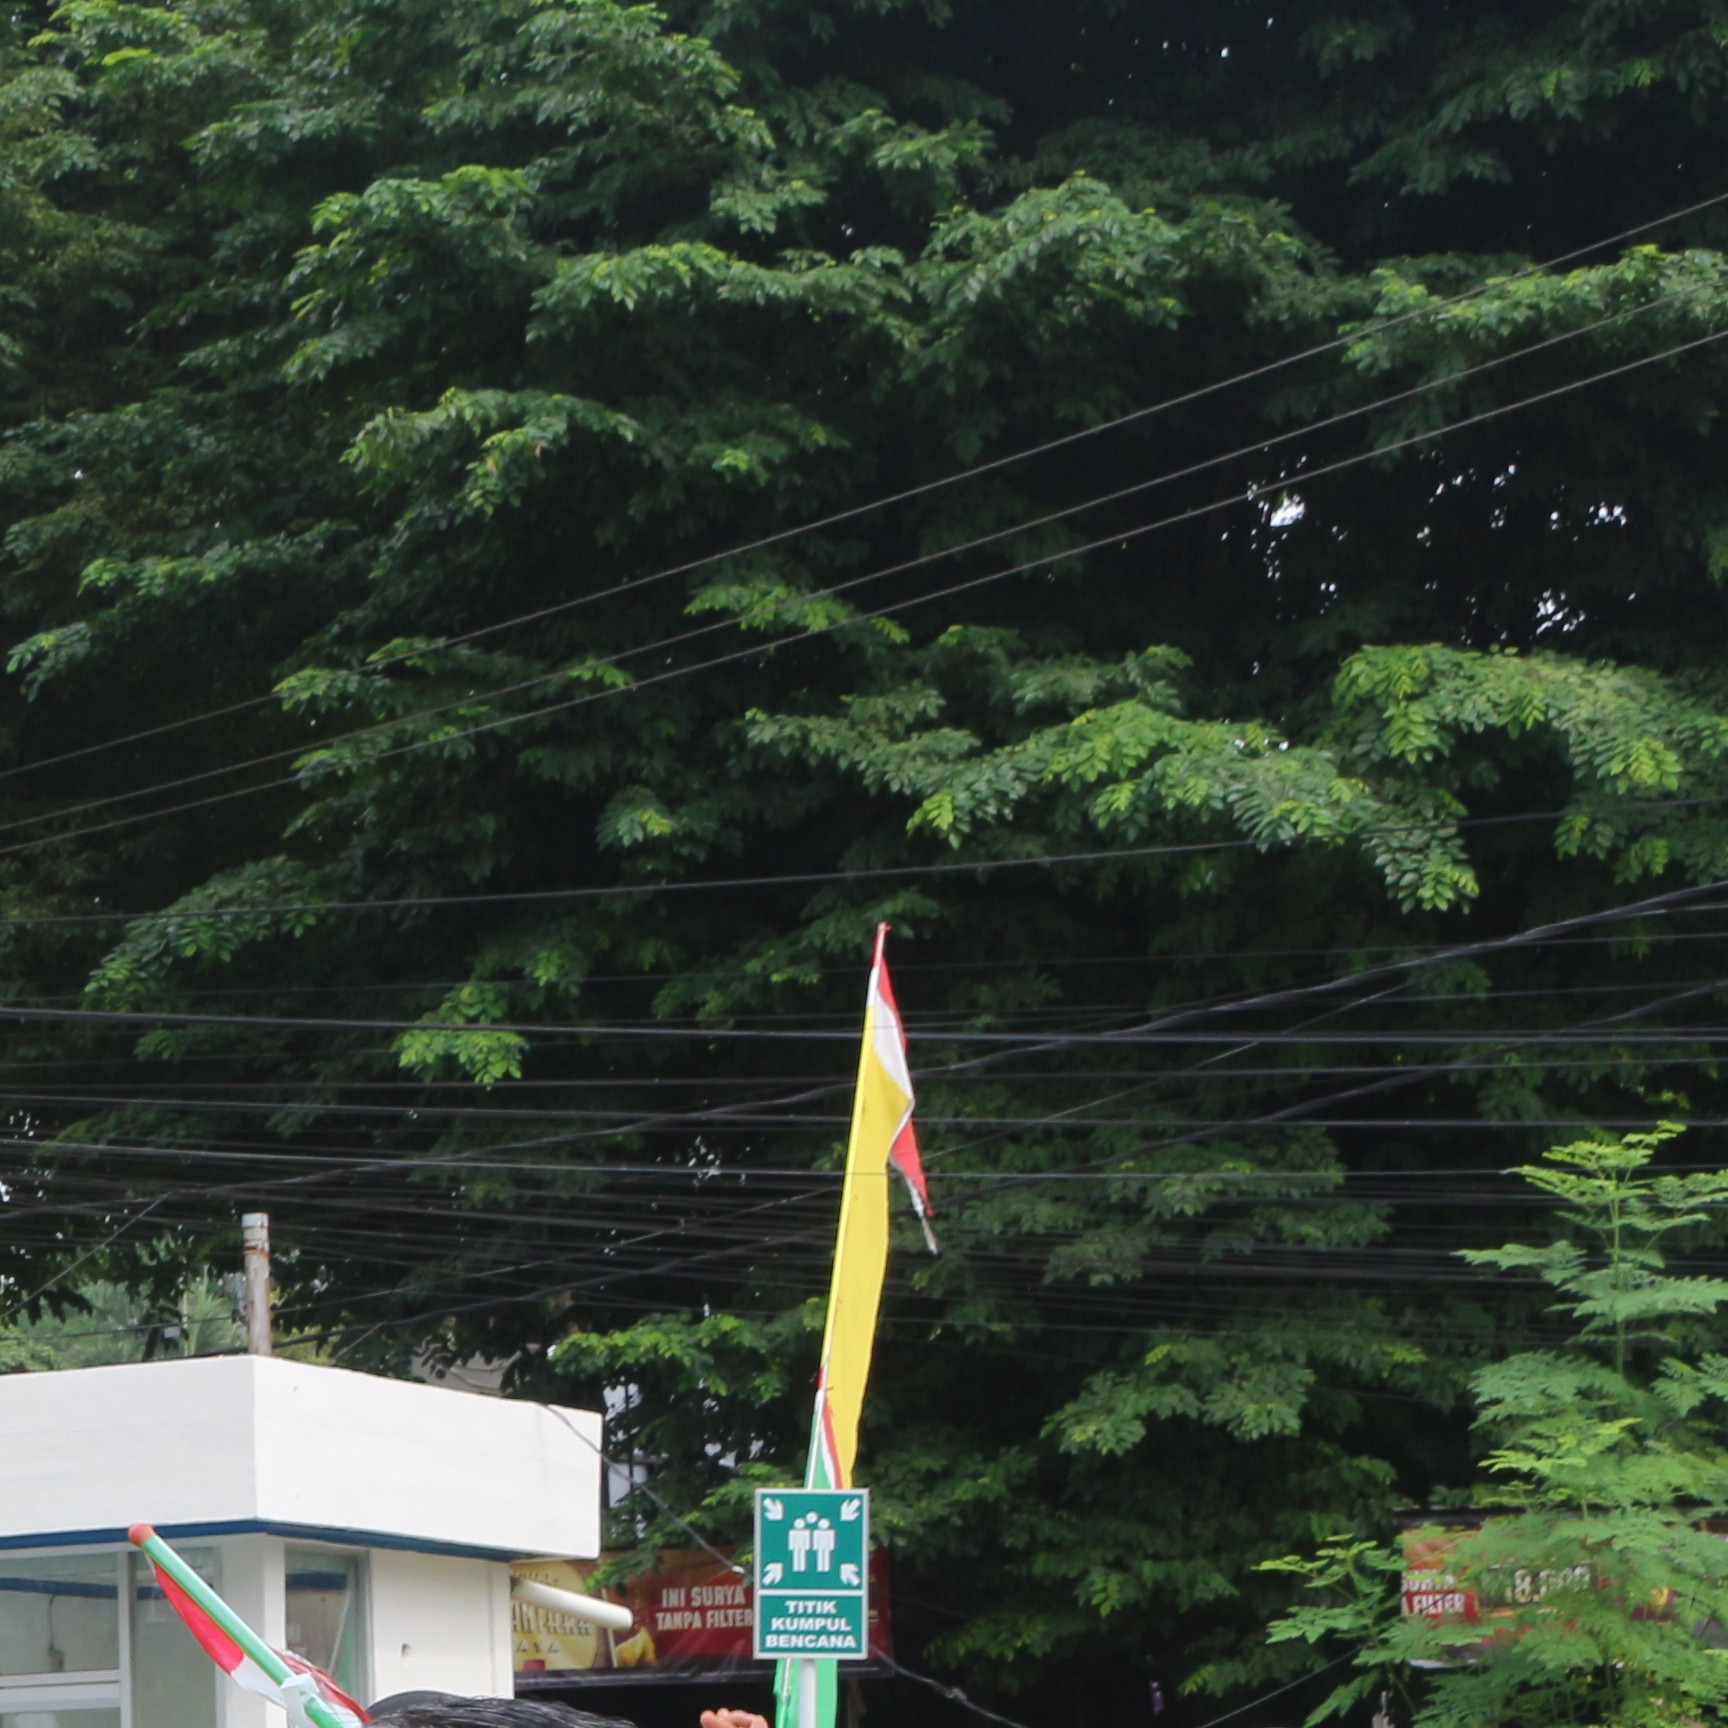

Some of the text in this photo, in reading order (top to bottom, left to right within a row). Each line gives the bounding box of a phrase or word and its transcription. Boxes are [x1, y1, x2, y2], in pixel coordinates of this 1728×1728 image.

[662, 1585, 747, 1608] INI SURYA
[785, 1600, 838, 1614] TITIK
[656, 1608, 753, 1631] TANPA FILTER
[771, 1617, 852, 1631] KUMPUL
[765, 1634, 857, 1649] BENCANA
